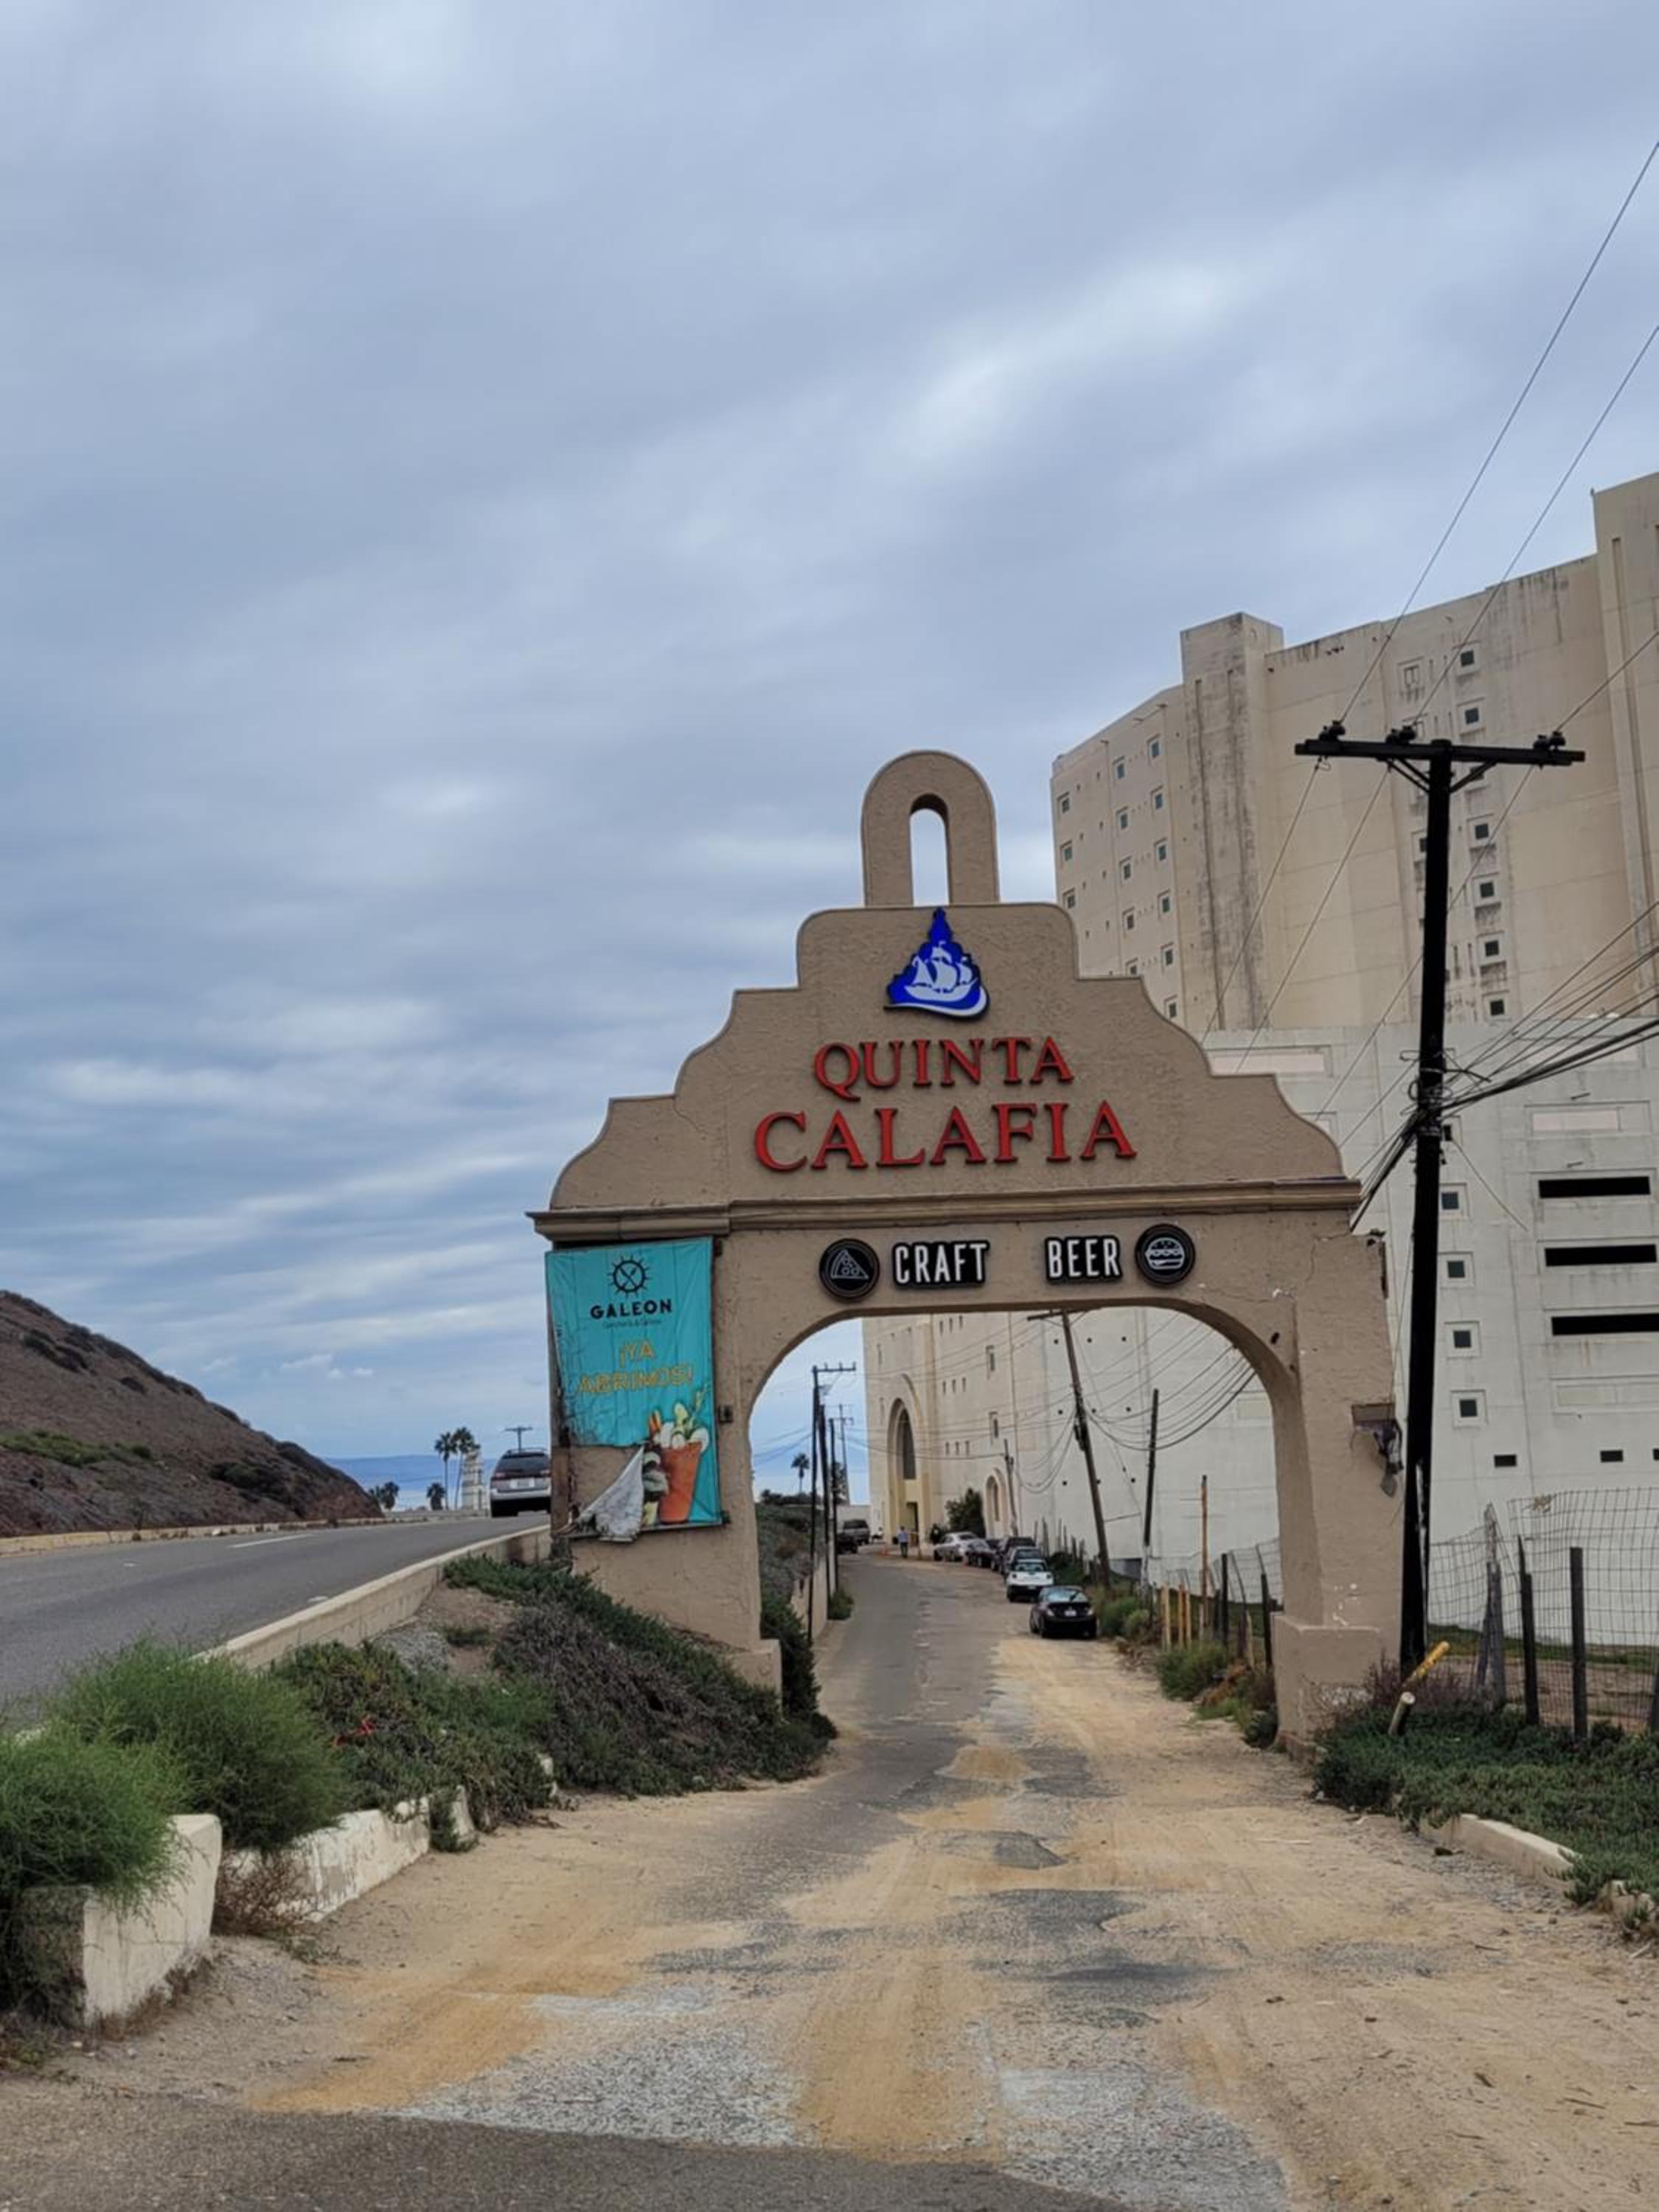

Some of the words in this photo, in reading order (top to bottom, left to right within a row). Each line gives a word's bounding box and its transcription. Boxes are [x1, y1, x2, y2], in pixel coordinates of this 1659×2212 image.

[813, 1036, 1074, 1102] QUINTA
[754, 1100, 1137, 1172] CALAFIA
[894, 1243, 988, 1284] CRAFT
[1047, 1239, 1121, 1279] BEER
[590, 1299, 672, 1320] GALEON
